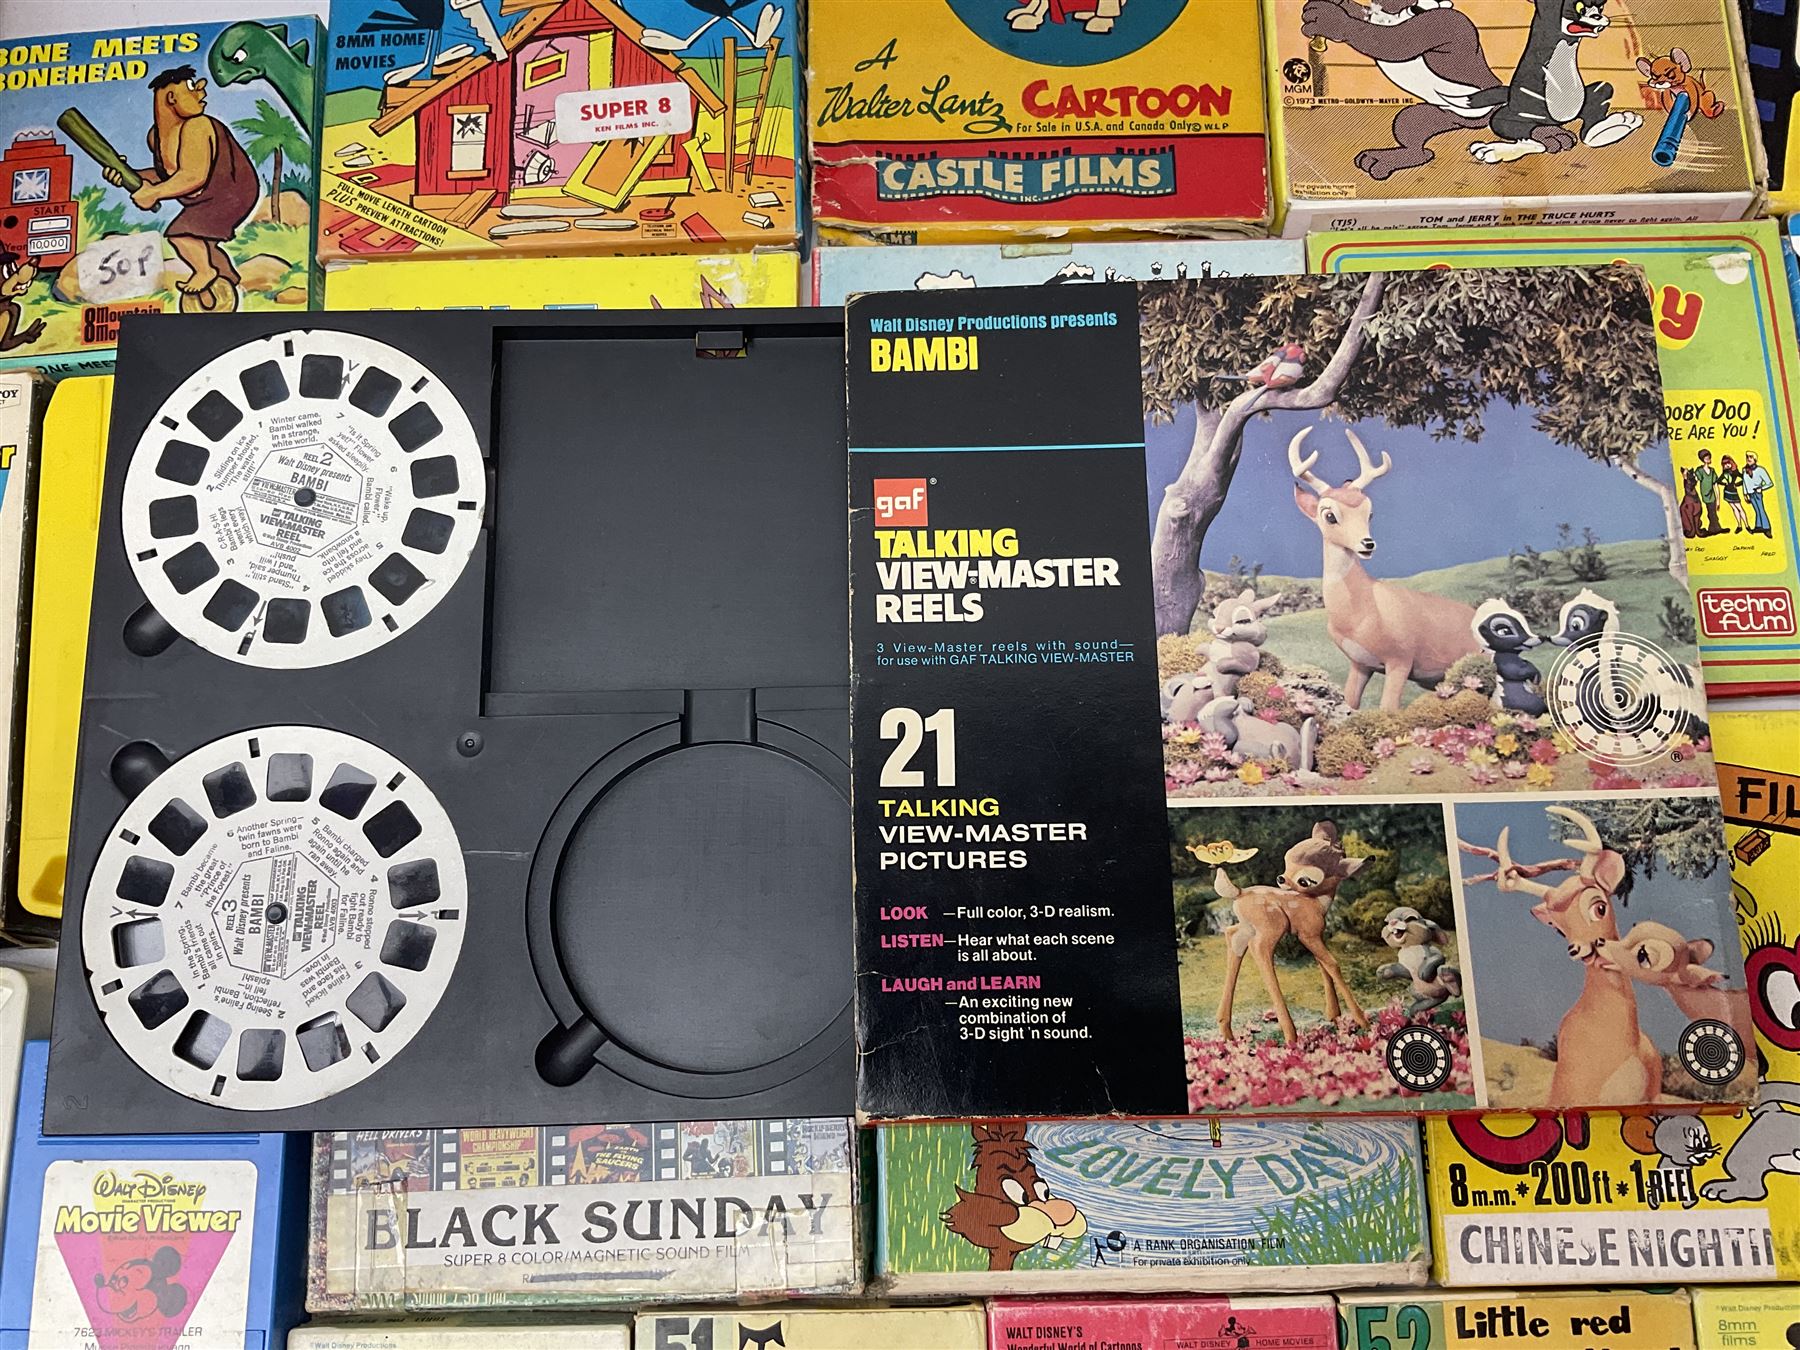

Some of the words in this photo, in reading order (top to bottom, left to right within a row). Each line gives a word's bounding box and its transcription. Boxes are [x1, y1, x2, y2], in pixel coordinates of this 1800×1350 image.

[92, 32, 199, 58] MEETS
[335, 33, 377, 49] 8MM
[380, 30, 426, 46] HOME
[335, 54, 396, 71] MOVIES
[855, 38, 898, 72] A
[1285, 85, 1312, 93] MGM
[580, 100, 647, 121] SUPER
[658, 97, 672, 114] 8
[817, 87, 911, 128] Walter
[917, 75, 1013, 134] Lantz
[1021, 79, 1233, 120] CARTOON
[595, 125, 613, 134] KEN
[616, 123, 639, 133] FILMS
[642, 121, 659, 130] INC.
[1017, 124, 1032, 134] For
[1036, 123, 1056, 133] Sale
[1060, 123, 1070, 132] in
[1075, 123, 1103, 133] U.S.A.
[1106, 122, 1124, 132] and
[1129, 121, 1164, 132] Canada
[1169, 121, 1192, 134] Only
[882, 158, 1024, 191] CASTLE
[1041, 152, 1161, 192] FILMS
[34, 205, 66, 215] START
[337, 182, 355, 194] FULL
[357, 191, 381, 206] MOVIE
[382, 201, 411, 219] LENGTH
[413, 214, 448, 235] CARTOON
[326, 189, 357, 206] PLUS
[356, 203, 389, 222] PREVIEW
[390, 218, 444, 247] ATTRACTIONS!
[1447, 215, 1464, 223] and
[1468, 214, 1499, 223] JERRY
[1518, 213, 1538, 221] THE
[1542, 212, 1576, 220] TRUCE
[870, 318, 902, 332] Walt
[906, 316, 954, 332] Disney
[958, 314, 1046, 330] Productions
[1051, 311, 1117, 329] presents
[870, 336, 978, 372] BAMBI
[269, 423, 294, 432] Bambi
[296, 419, 322, 428] walked
[271, 416, 296, 424] Winter
[288, 429, 319, 437] strange,
[1688, 424, 1715, 440] ARE
[272, 439, 292, 448] white
[295, 436, 318, 444] world.
[303, 453, 319, 463] REEL
[320, 452, 333, 466] 2
[278, 455, 295, 467] Walt
[296, 460, 320, 475] Disney
[320, 467, 352, 482] presents
[291, 472, 329, 491] BAMBI
[876, 488, 924, 518] gaf
[284, 511, 322, 528] TALKING
[277, 529, 301, 542] REEL
[874, 528, 1018, 558] TALKING
[876, 558, 1121, 590] VIEW-MASTER
[876, 592, 984, 623] REELS
[1704, 594, 1786, 613] techno
[877, 643, 884, 652] 3
[894, 642, 982, 653] View-Master
[992, 641, 1027, 652] reels
[1036, 640, 1066, 650] with
[877, 655, 893, 666] for
[897, 657, 918, 666] use
[922, 655, 946, 665] with
[950, 654, 976, 665] GAF
[980, 653, 1038, 664] TALKING
[1041, 652, 1134, 663] VIEW-MASTER
[880, 708, 956, 787] 21
[878, 798, 999, 817] TALKING
[879, 823, 1087, 844] VIEW-MASTER
[880, 851, 1028, 870] PICTURES
[222, 899, 237, 913] 3
[249, 894, 264, 934] BAMBI
[880, 906, 927, 920] LOOK
[987, 906, 1026, 919] color,
[1030, 905, 1055, 917] 3-D
[1059, 905, 1115, 917] realism.
[226, 914, 235, 930] REEL
[881, 934, 943, 948] LISTEN
[996, 934, 1030, 946] what
[1034, 933, 1068, 945] each
[1071, 934, 1114, 944] scene
[958, 950, 969, 962] is
[972, 950, 989, 961] all
[992, 950, 1037, 961] about.
[881, 978, 943, 992] LAUGH
[947, 977, 977, 990] and
[980, 976, 1040, 990] LEARN
[982, 995, 1039, 1010] exciting
[1043, 996, 1072, 1007] new
[959, 1012, 1049, 1024] combination
[1052, 1011, 1066, 1023] of
[960, 1028, 986, 1039] 3-D
[989, 1027, 1024, 1042] sight
[1044, 1026, 1092, 1039] sound.
[1043, 1138, 1242, 1199] LOVELY
[1254, 1135, 1368, 1191] DAY
[94, 1171, 137, 1198] WALT
[1530, 1162, 1613, 1206] 200ft
[54, 1205, 141, 1234] Movie
[141, 1204, 241, 1234] Viewer
[365, 1203, 560, 1250] BLACK
[581, 1193, 833, 1244] SUNDAY
[1134, 1240, 1141, 1251] A
[1146, 1240, 1175, 1250] RANK
[1180, 1238, 1255, 1250] ORGANISATION
[1262, 1238, 1286, 1249] FILM
[443, 1253, 493, 1267] SUPER
[498, 1253, 507, 1266] 8
[511, 1248, 651, 1265] COLOR/MAGNETIC
[656, 1246, 710, 1260] SOUND
[716, 1244, 751, 1258] FILM
[1134, 1257, 1147, 1266] For
[1150, 1257, 1181, 1268] private
[1183, 1257, 1229, 1266] exhibition
[1231, 1256, 1251, 1267] only
[1455, 1305, 1550, 1339] Little
[1570, 1306, 1632, 1337] red
[1718, 1319, 1757, 1331] 8mm
[1006, 1327, 1033, 1339] WALT
[1036, 1326, 1083, 1338] DISNEY'S
[1722, 1334, 1756, 1346] films
[1256, 1338, 1279, 1347] HOME
[1283, 1337, 1314, 1346] MOVIES
